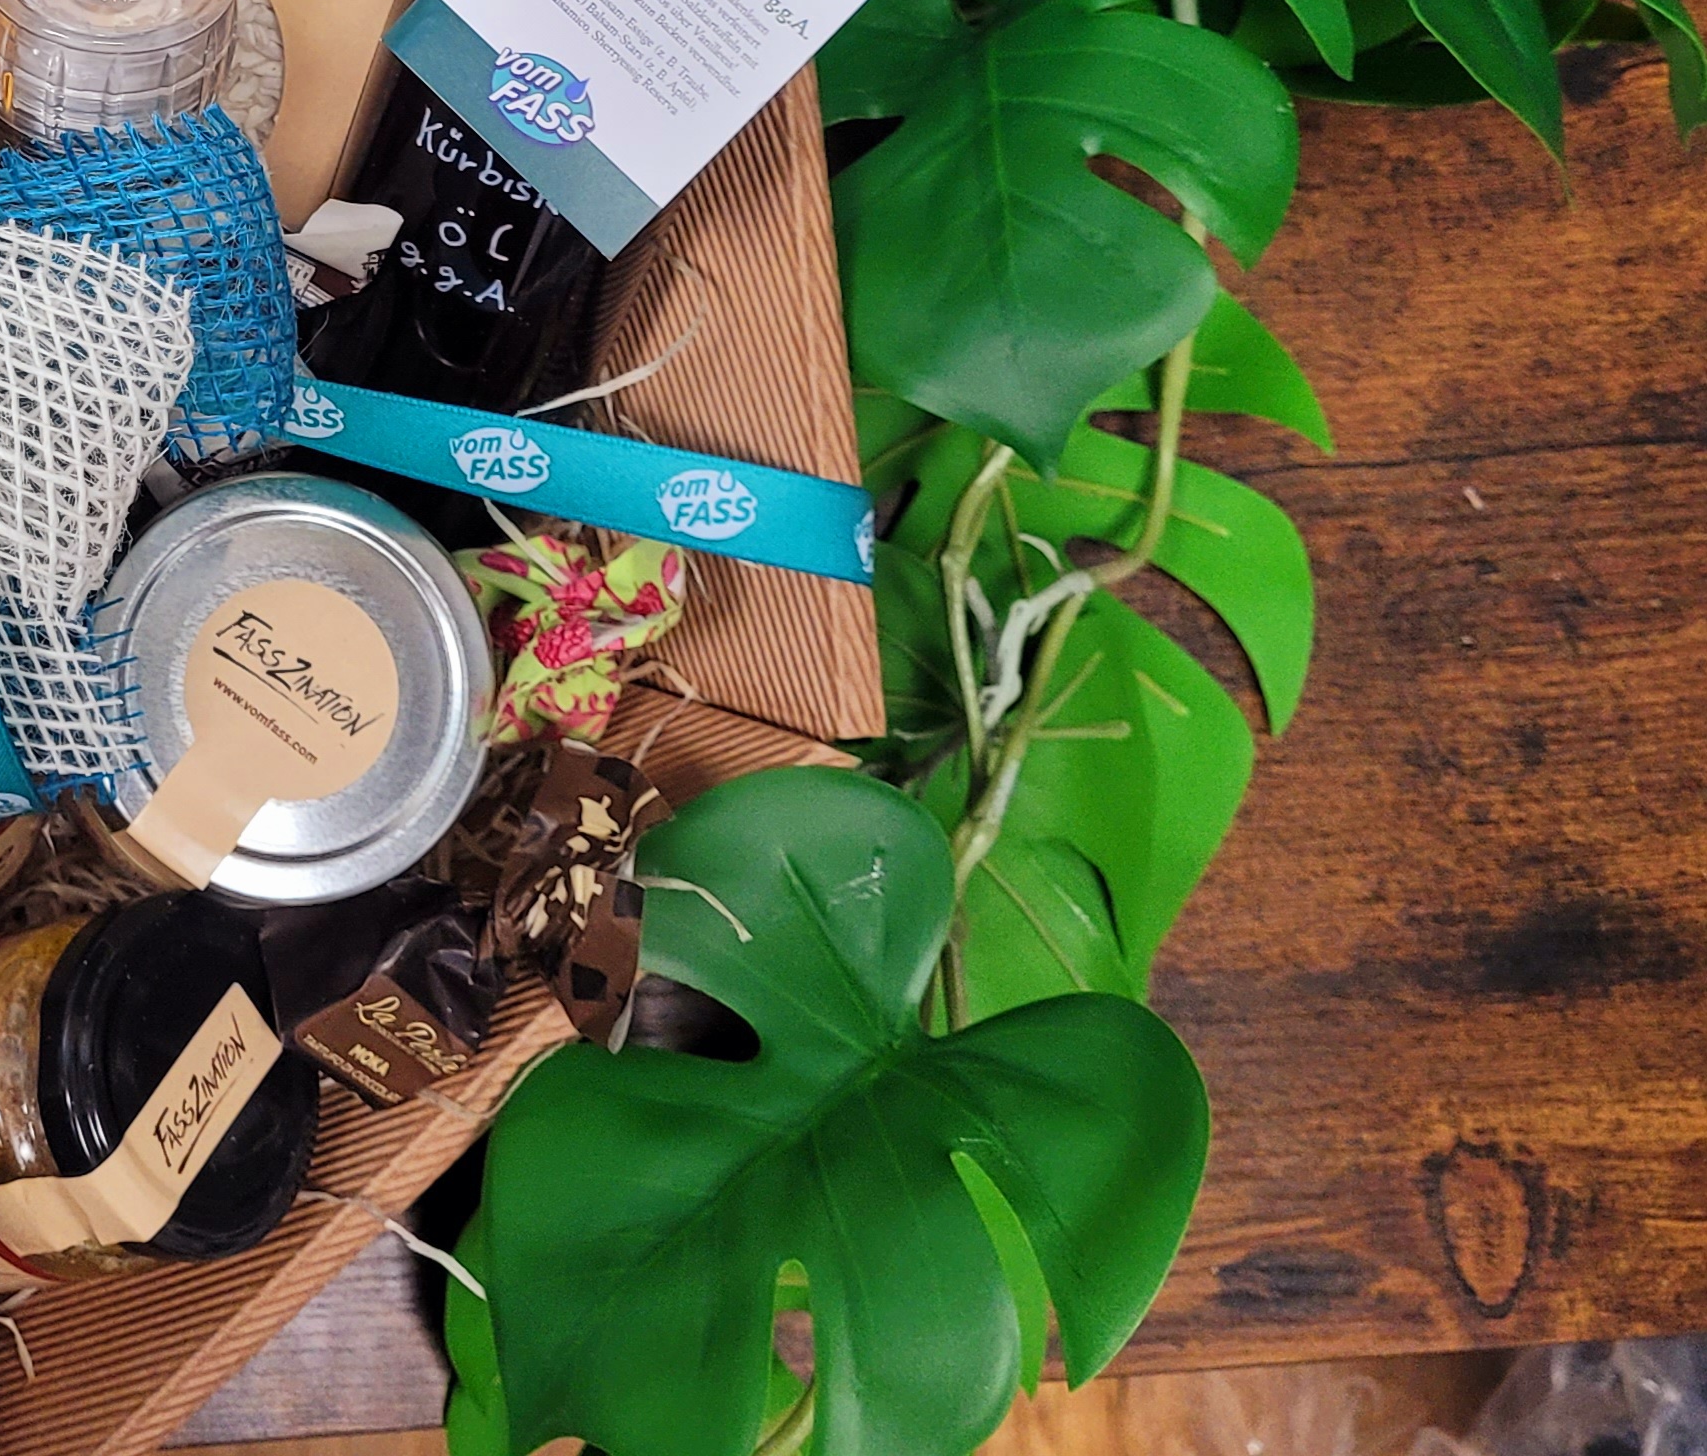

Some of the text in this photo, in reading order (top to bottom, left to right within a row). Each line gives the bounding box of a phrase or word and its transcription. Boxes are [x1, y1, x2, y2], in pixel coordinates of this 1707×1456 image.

[494, 47, 564, 94] vom
[489, 81, 595, 144] FASS
[450, 432, 501, 454] vom
[469, 454, 549, 481] FASS
[674, 496, 757, 527] FASS
[212, 676, 319, 765] www.vomfass.com
[348, 1043, 390, 1077] MOKA
